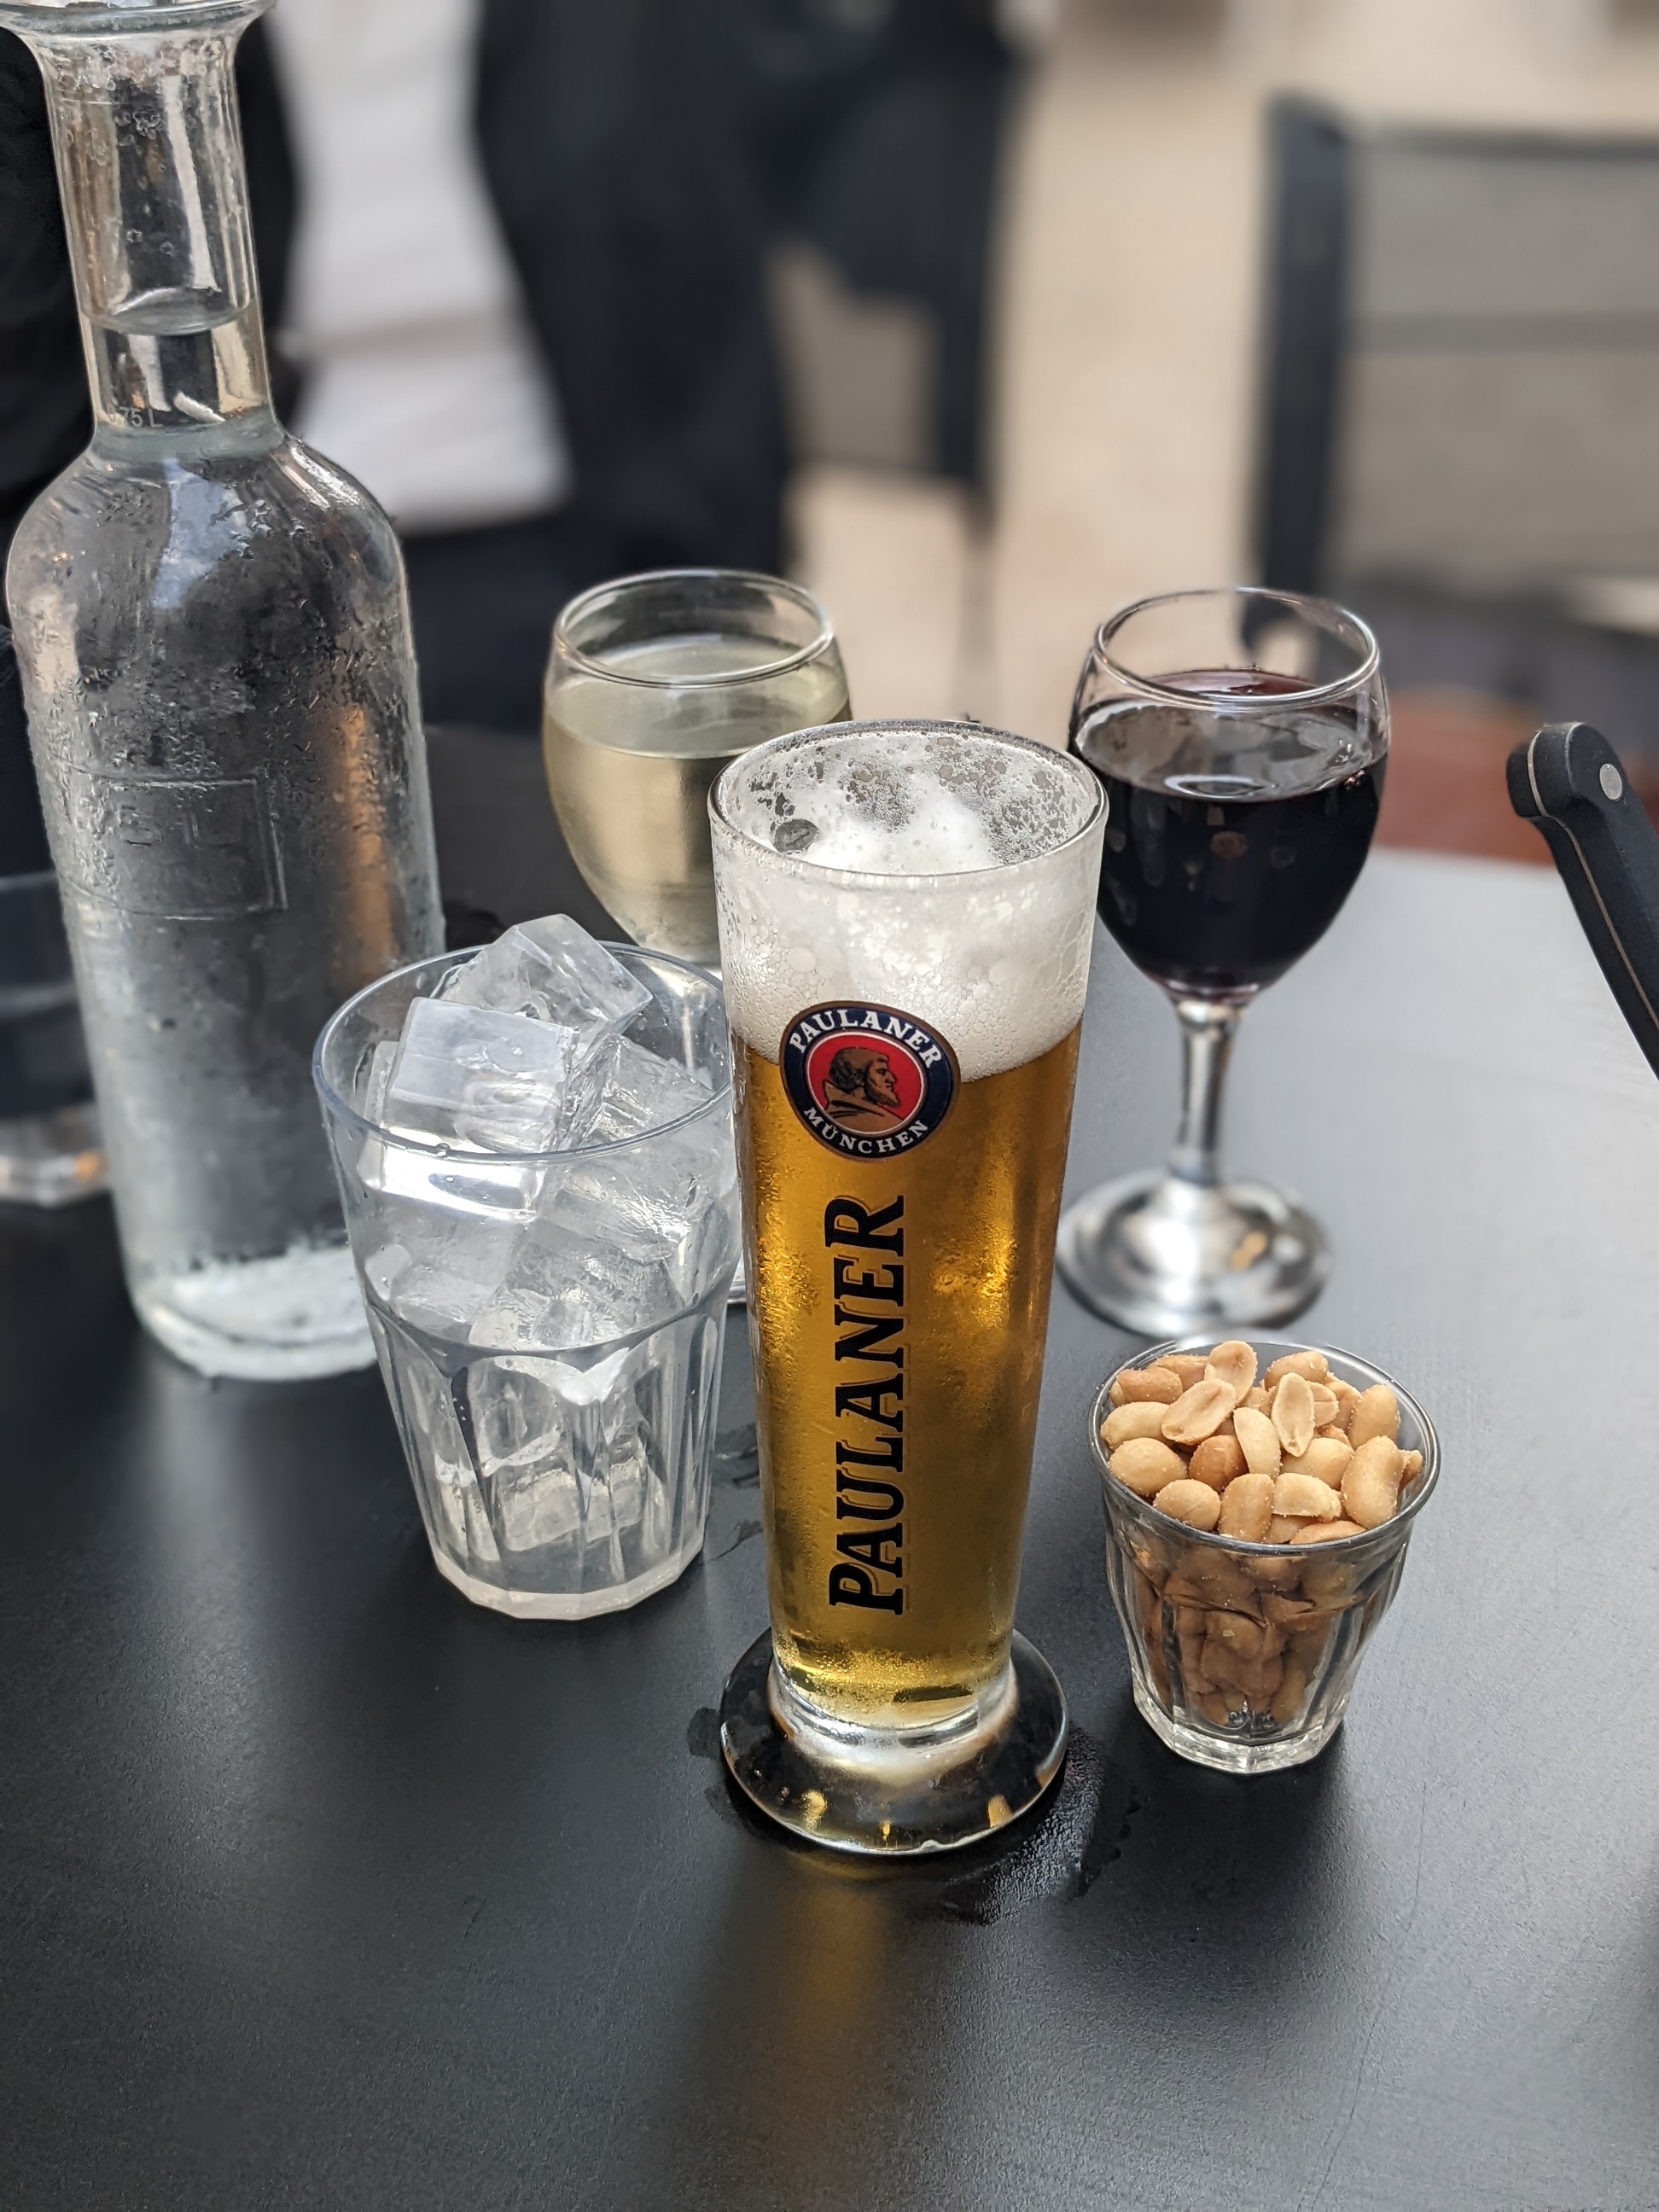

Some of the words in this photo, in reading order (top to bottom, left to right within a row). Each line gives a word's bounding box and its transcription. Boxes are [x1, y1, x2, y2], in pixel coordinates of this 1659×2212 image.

[789, 1009, 943, 1068] PAULANER
[804, 1106, 929, 1155] MÜNCHEN
[824, 1194, 907, 1615] PAULANER
